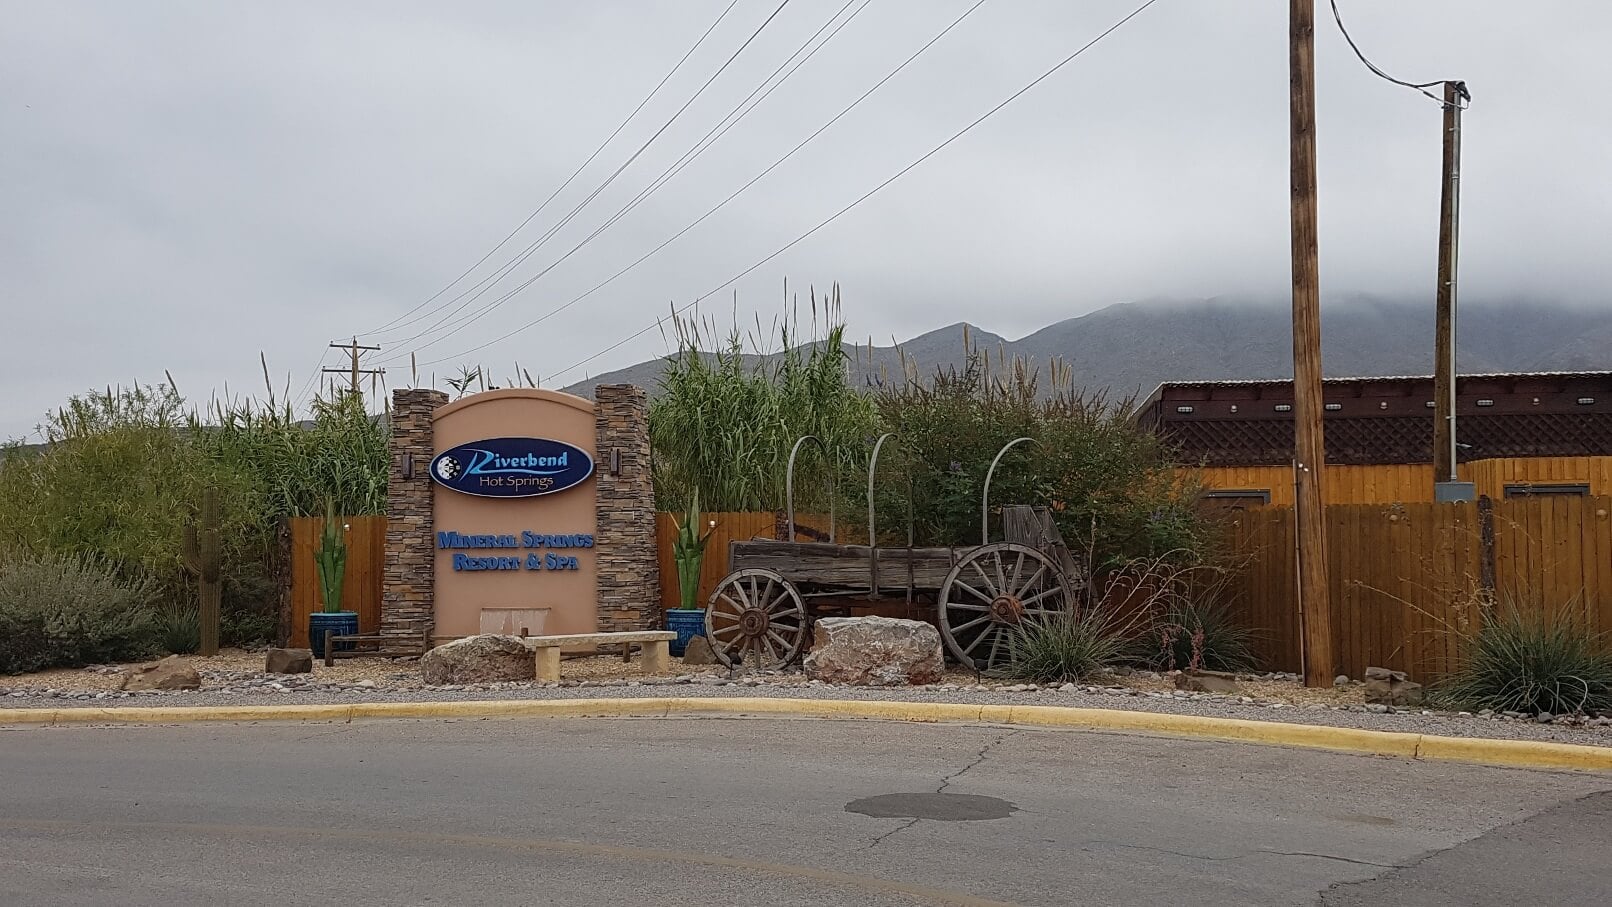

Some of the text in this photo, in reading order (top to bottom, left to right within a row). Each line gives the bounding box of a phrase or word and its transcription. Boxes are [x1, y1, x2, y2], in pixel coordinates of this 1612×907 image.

[460, 449, 570, 480] Riverbend
[479, 475, 554, 492] Hot Springs
[437, 530, 594, 549] MINERAL SPRINGS
[453, 552, 578, 571] RESORT & SPA
